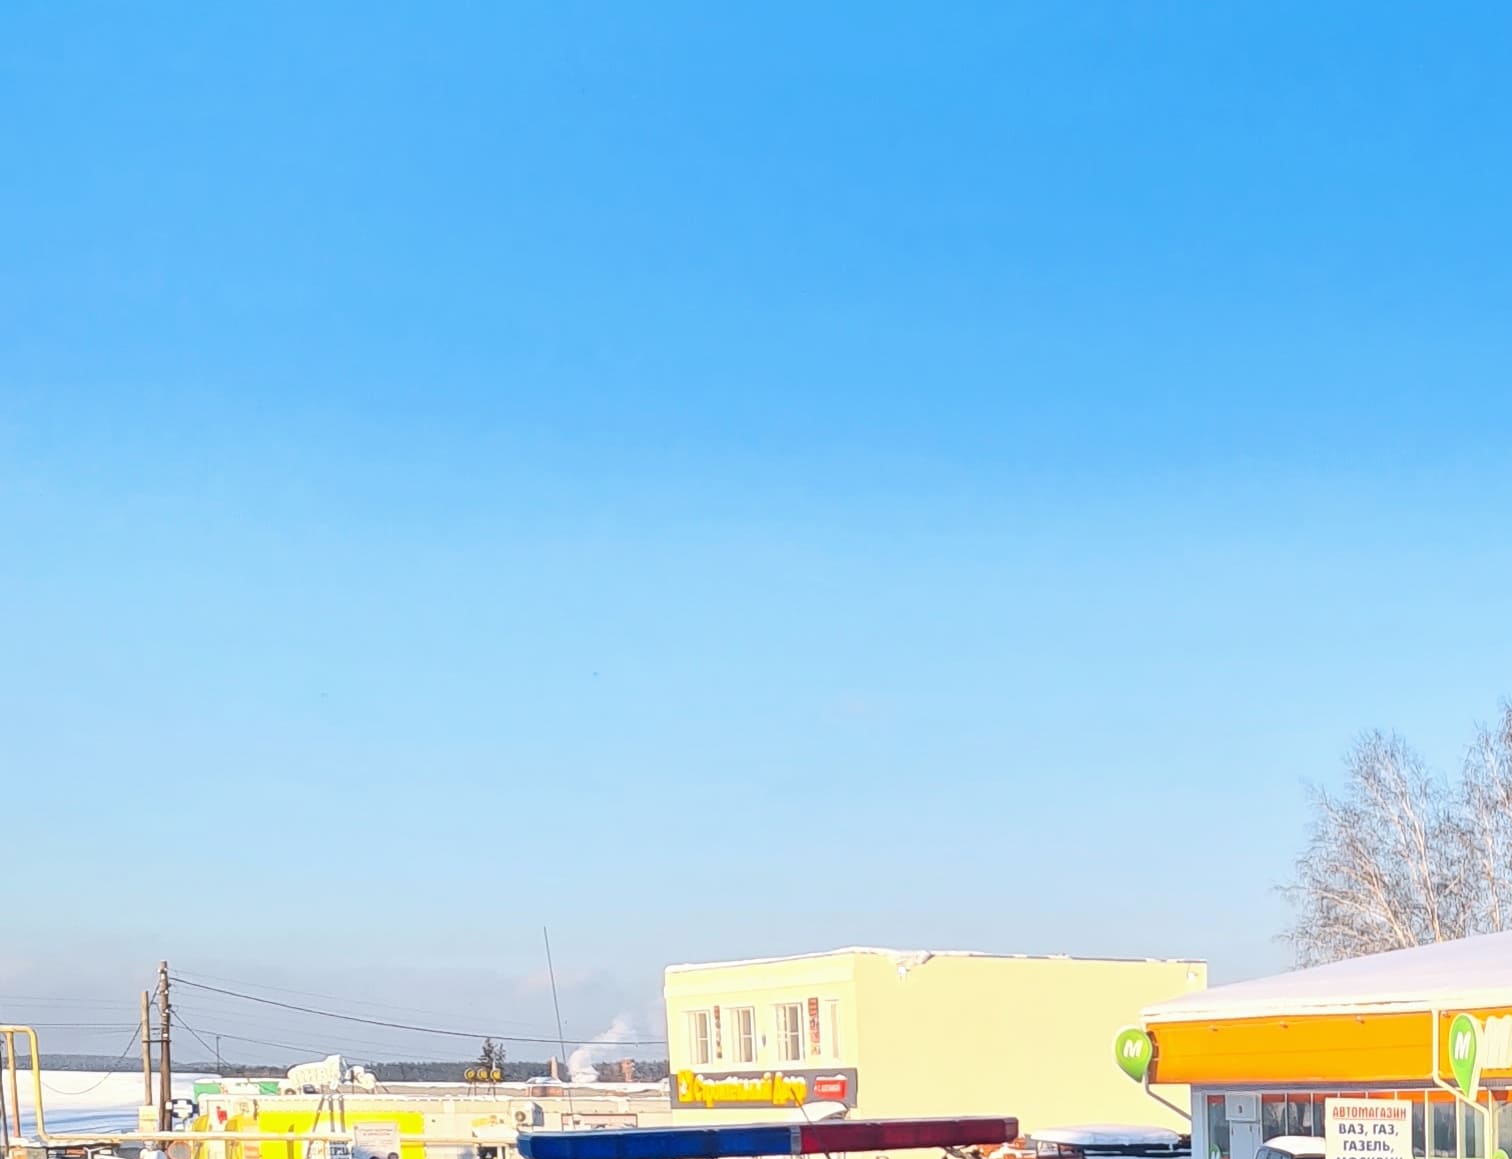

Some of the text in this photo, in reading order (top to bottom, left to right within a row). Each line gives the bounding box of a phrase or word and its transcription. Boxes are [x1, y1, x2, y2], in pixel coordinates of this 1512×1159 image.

[1332, 1106, 1407, 1120] АВТОМАГАЗИН
[1338, 1123, 1399, 1136] ВАЗ, ГАЗ,
[1343, 1140, 1394, 1153] ГАЗЕЛЬ,
